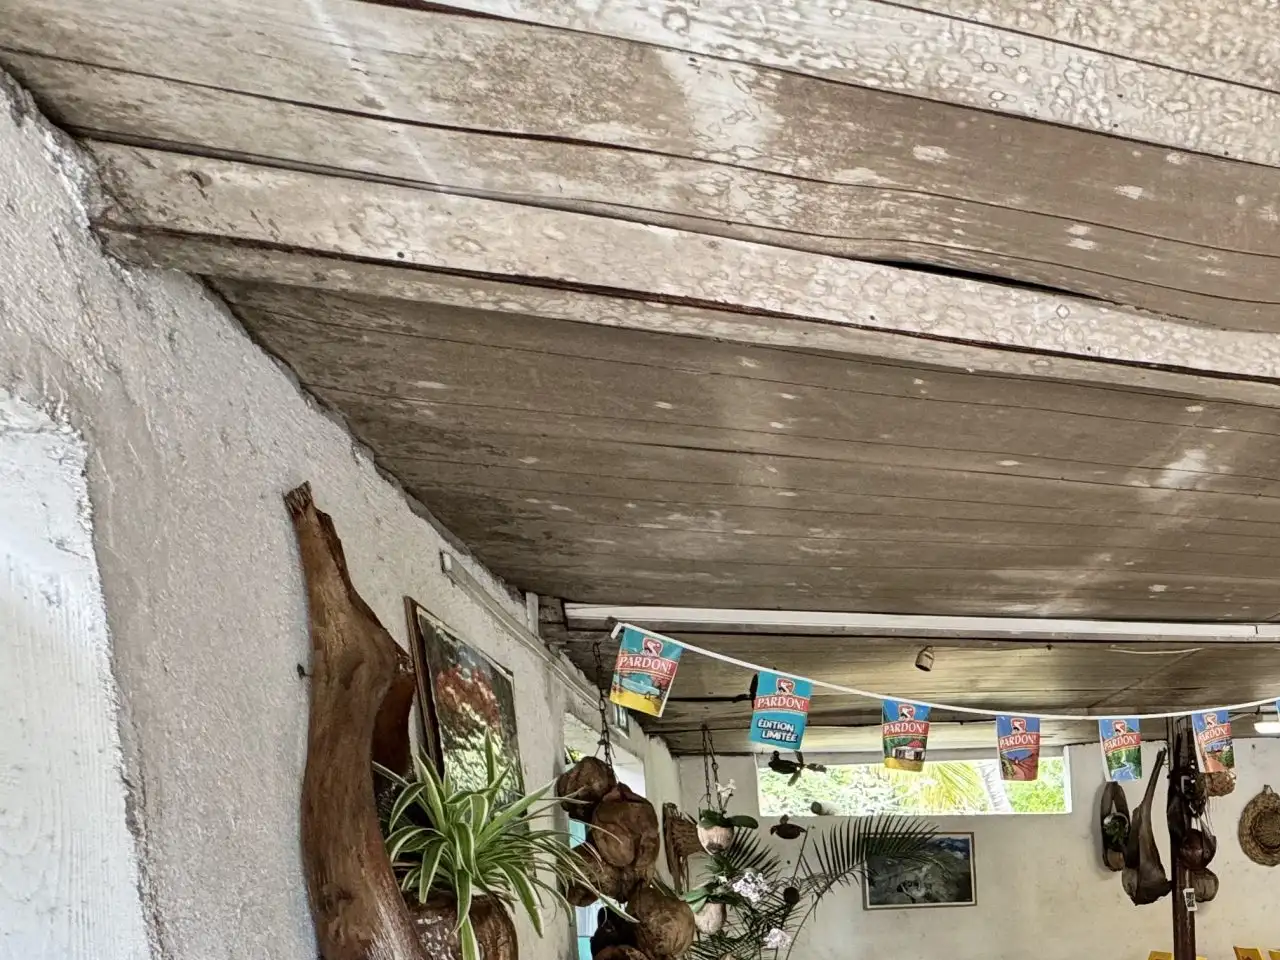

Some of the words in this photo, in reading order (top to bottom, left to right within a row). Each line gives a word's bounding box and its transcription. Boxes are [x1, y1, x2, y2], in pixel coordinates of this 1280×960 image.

[618, 654, 673, 675] PARDON!
[757, 696, 806, 710] PARDON!
[757, 717, 794, 732] ÉDITION
[883, 722, 925, 735] PARDON!
[762, 729, 798, 743] LIMITÉE
[1000, 735, 1037, 748] PARDON!
[1103, 733, 1138, 751] PARDON!
